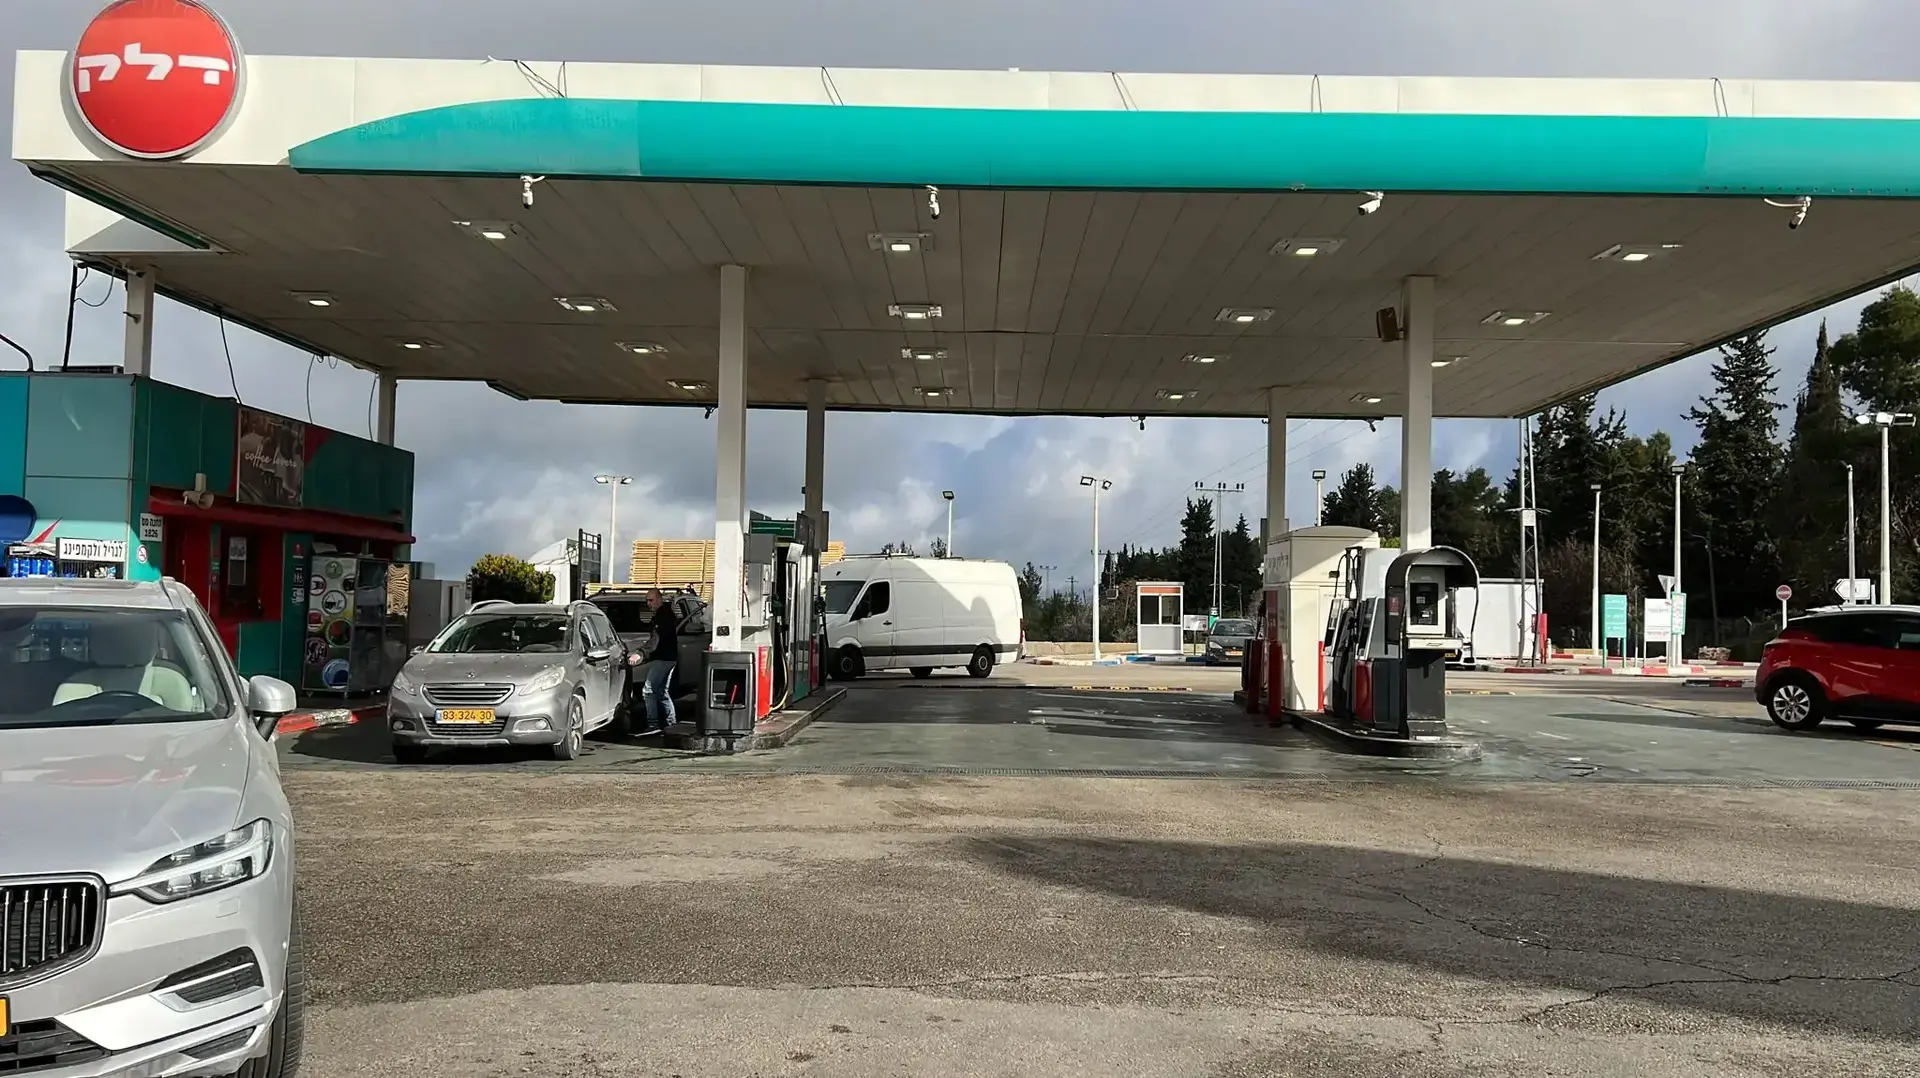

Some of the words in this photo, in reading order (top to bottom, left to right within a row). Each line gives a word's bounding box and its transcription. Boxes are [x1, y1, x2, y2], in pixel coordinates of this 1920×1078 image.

[78, 42, 230, 93] דלק
[244, 442, 272, 468] coffee
[273, 447, 298, 468] lovers
[63, 543, 101, 558] ולקמפינג
[103, 543, 123, 558] לגריל
